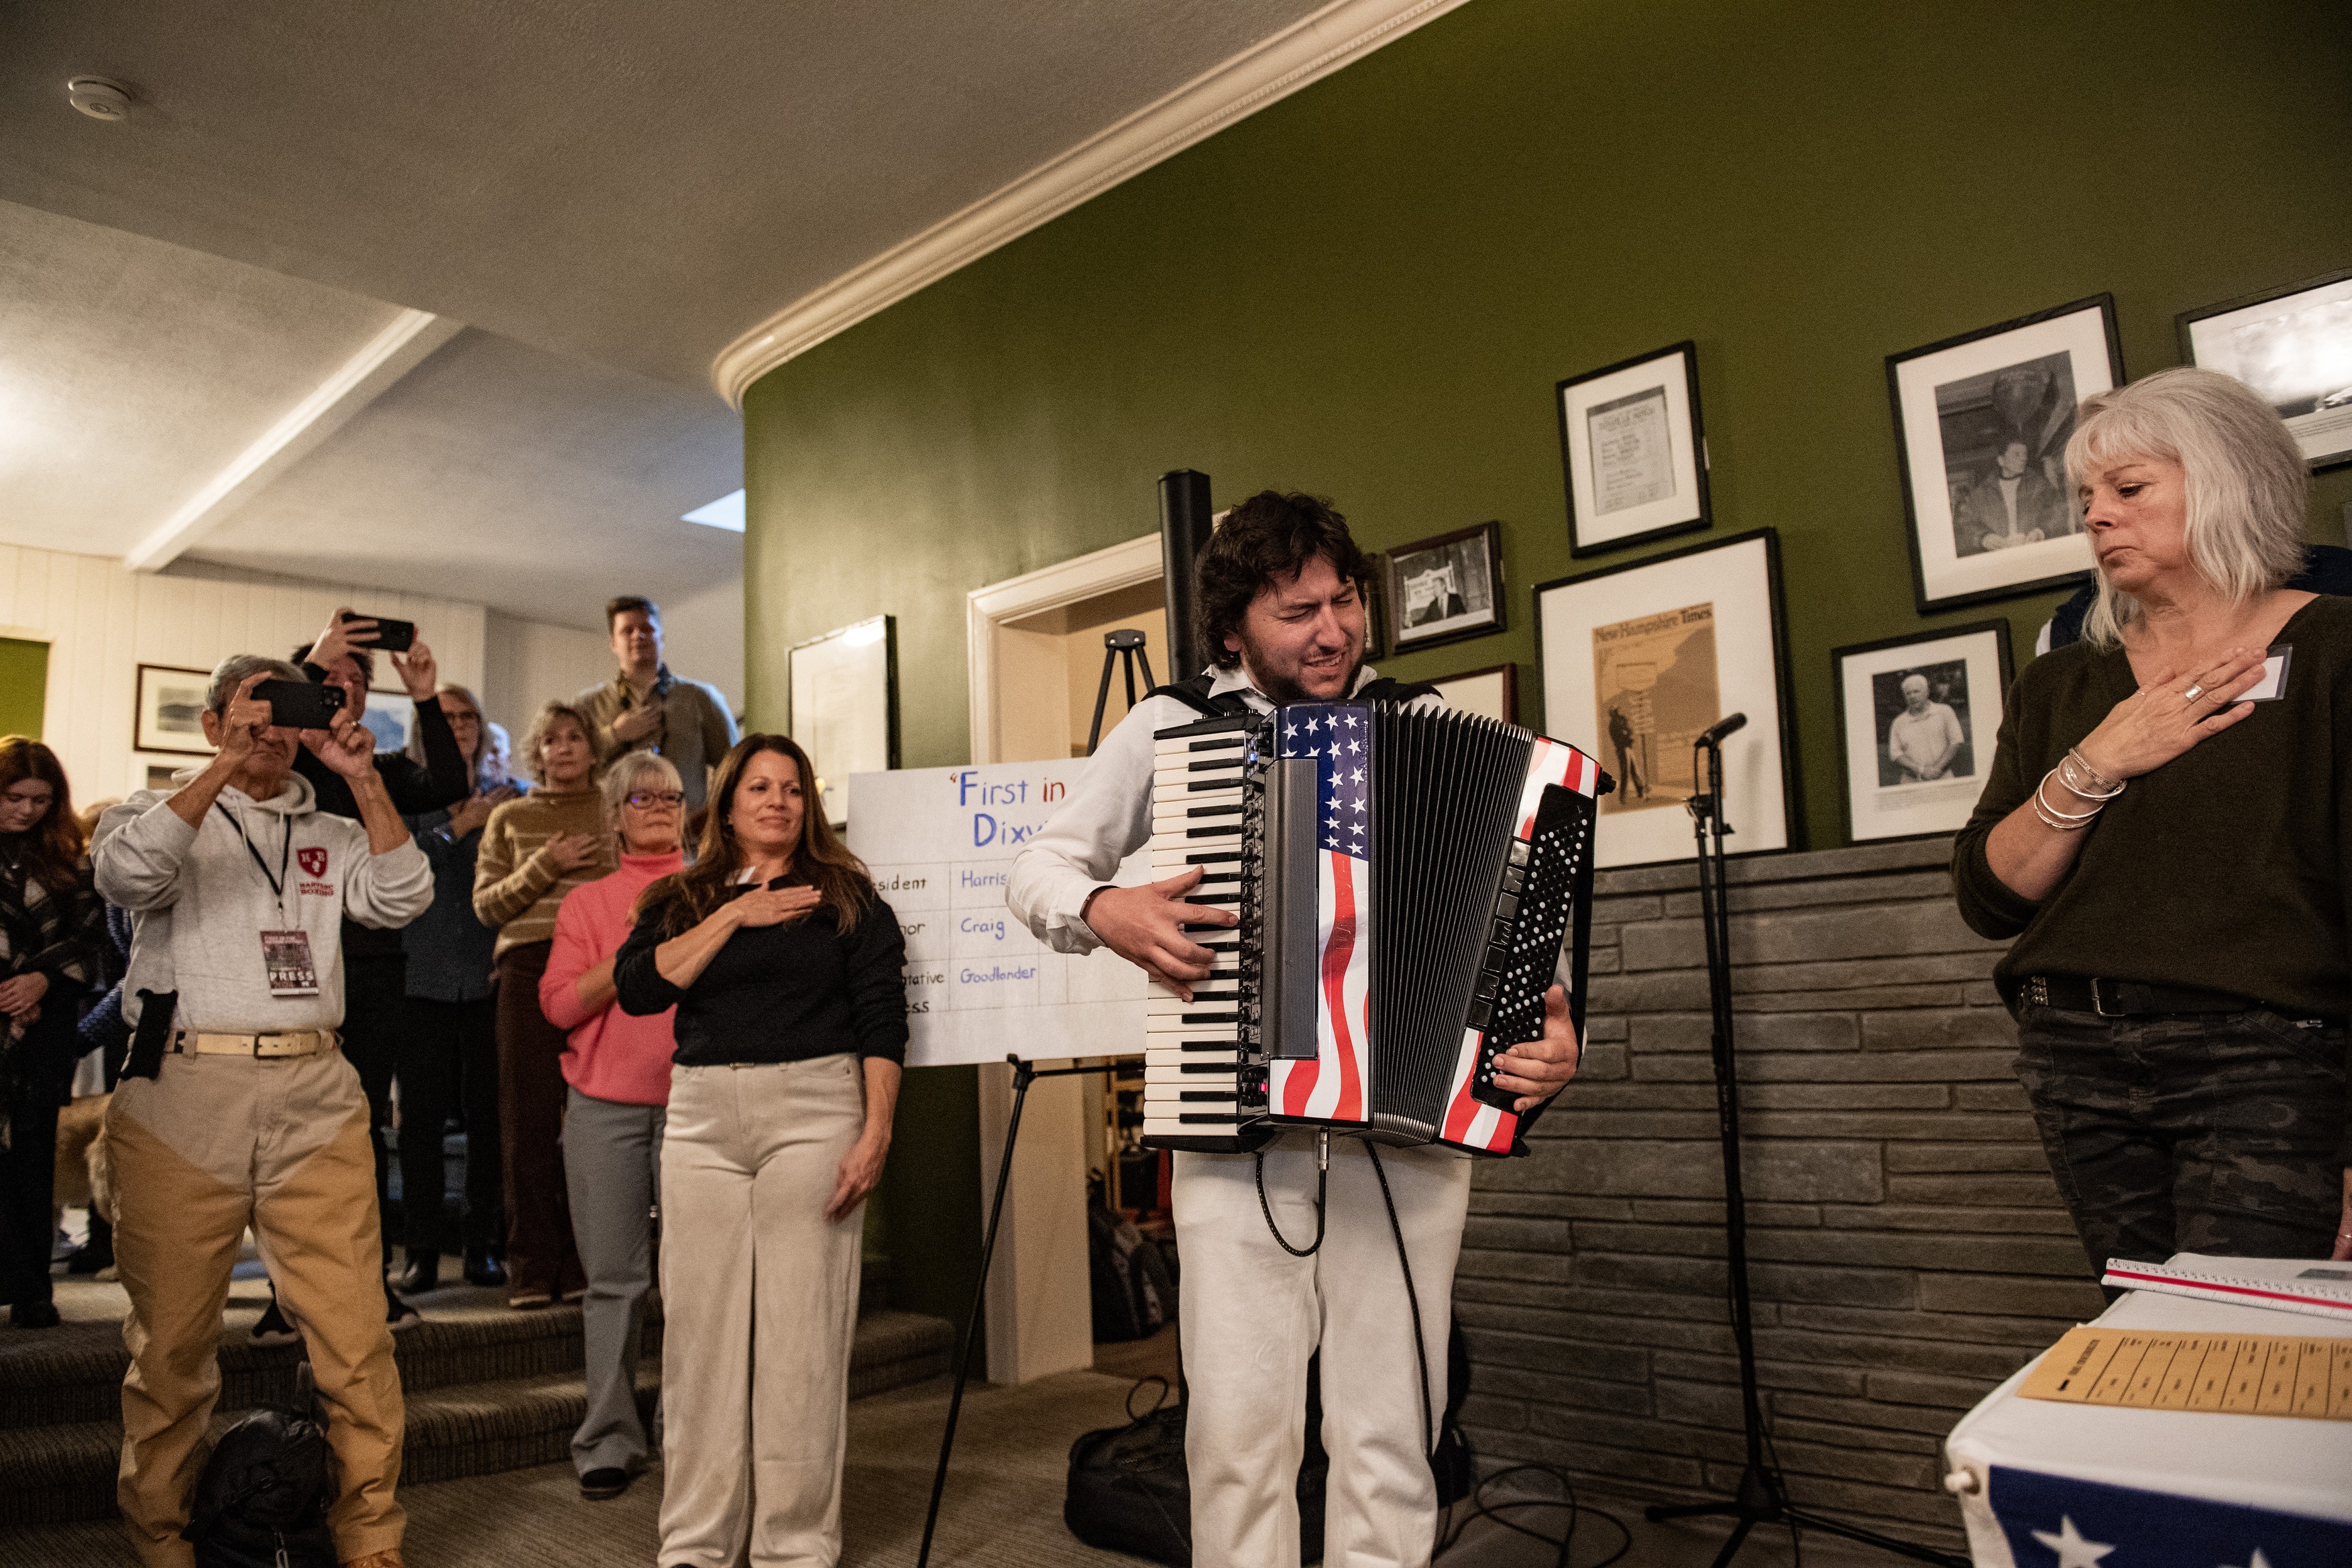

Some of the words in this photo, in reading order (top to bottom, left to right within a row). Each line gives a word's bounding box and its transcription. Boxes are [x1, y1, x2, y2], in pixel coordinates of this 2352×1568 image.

[1681, 608, 1712, 624] Times
[1043, 777, 1065, 803] in
[872, 873, 927, 891] sident
[962, 871, 1007, 888] Harris
[961, 917, 1005, 940] Craig
[270, 971, 314, 982] PRESS
